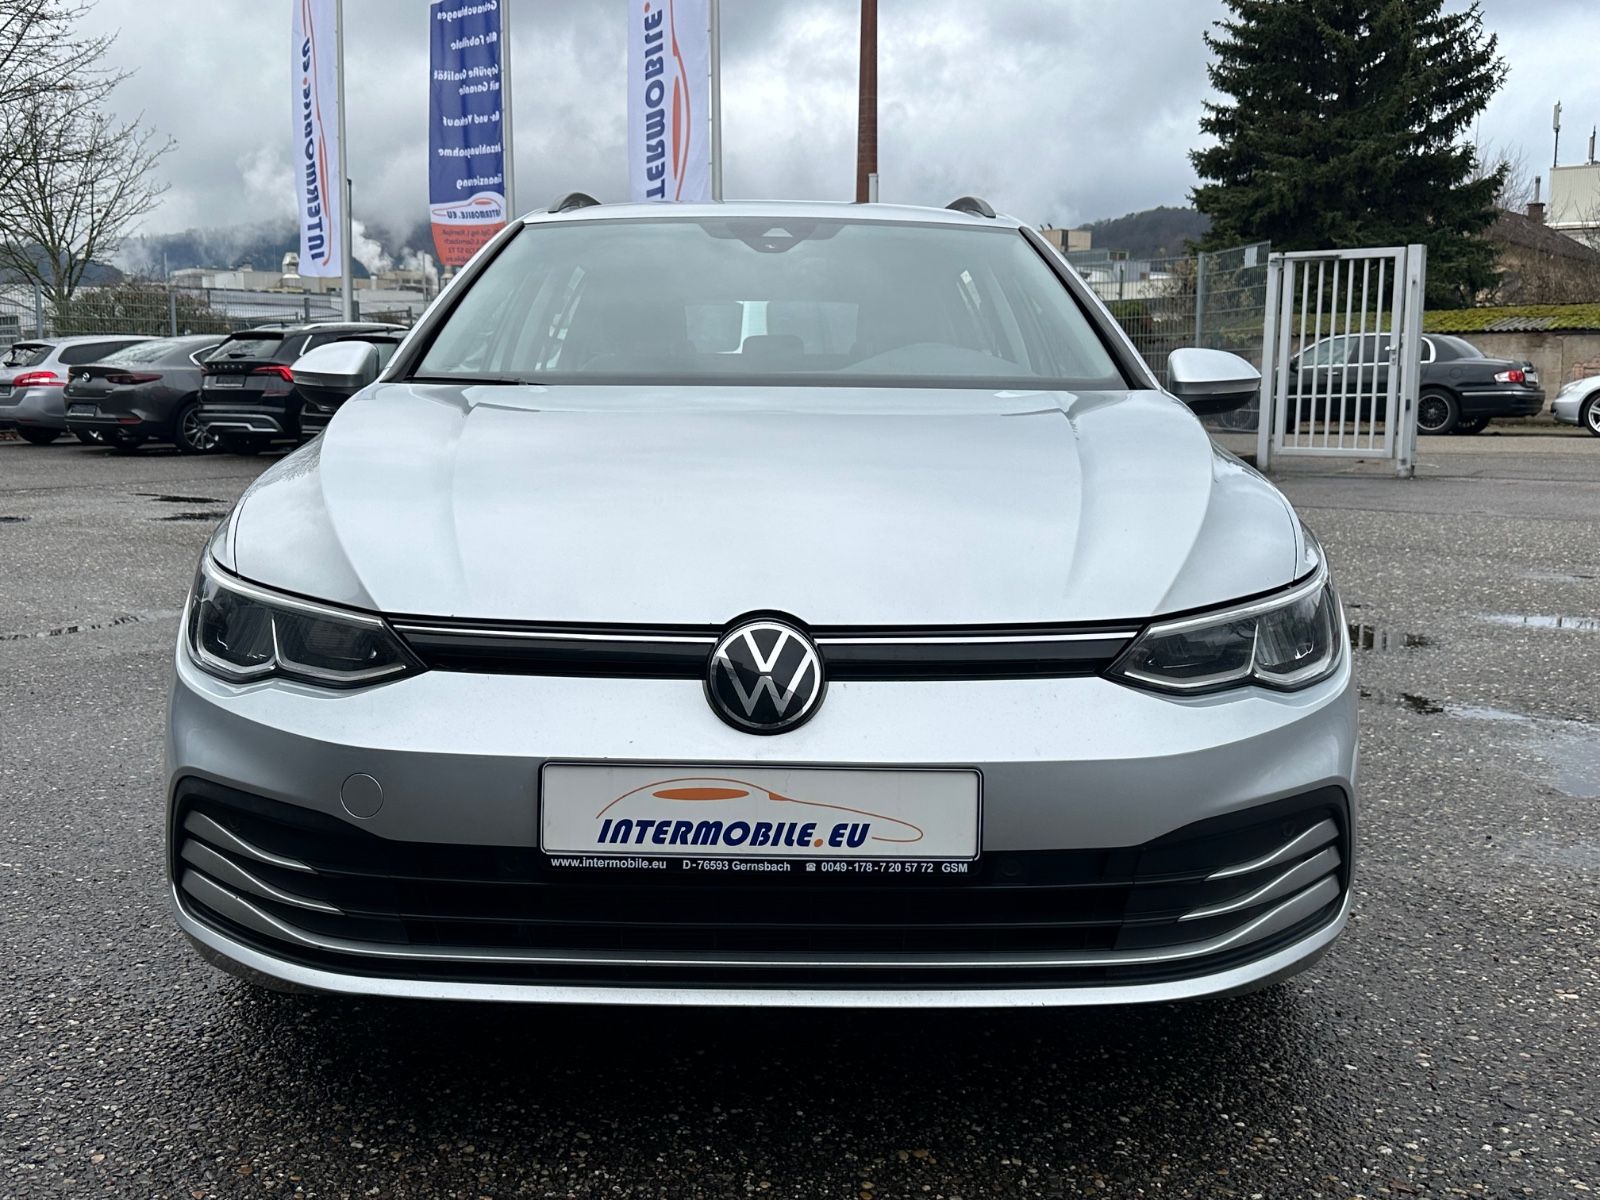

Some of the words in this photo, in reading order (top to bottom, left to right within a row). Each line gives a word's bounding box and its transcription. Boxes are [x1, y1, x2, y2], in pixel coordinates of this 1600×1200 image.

[597, 818, 871, 848] INTERMOBILE.EU
[551, 856, 667, 870] www.intermobile.eu
[682, 859, 729, 870] D-76593
[731, 860, 791, 872] Gernsbach
[941, 864, 968, 874] GSM
